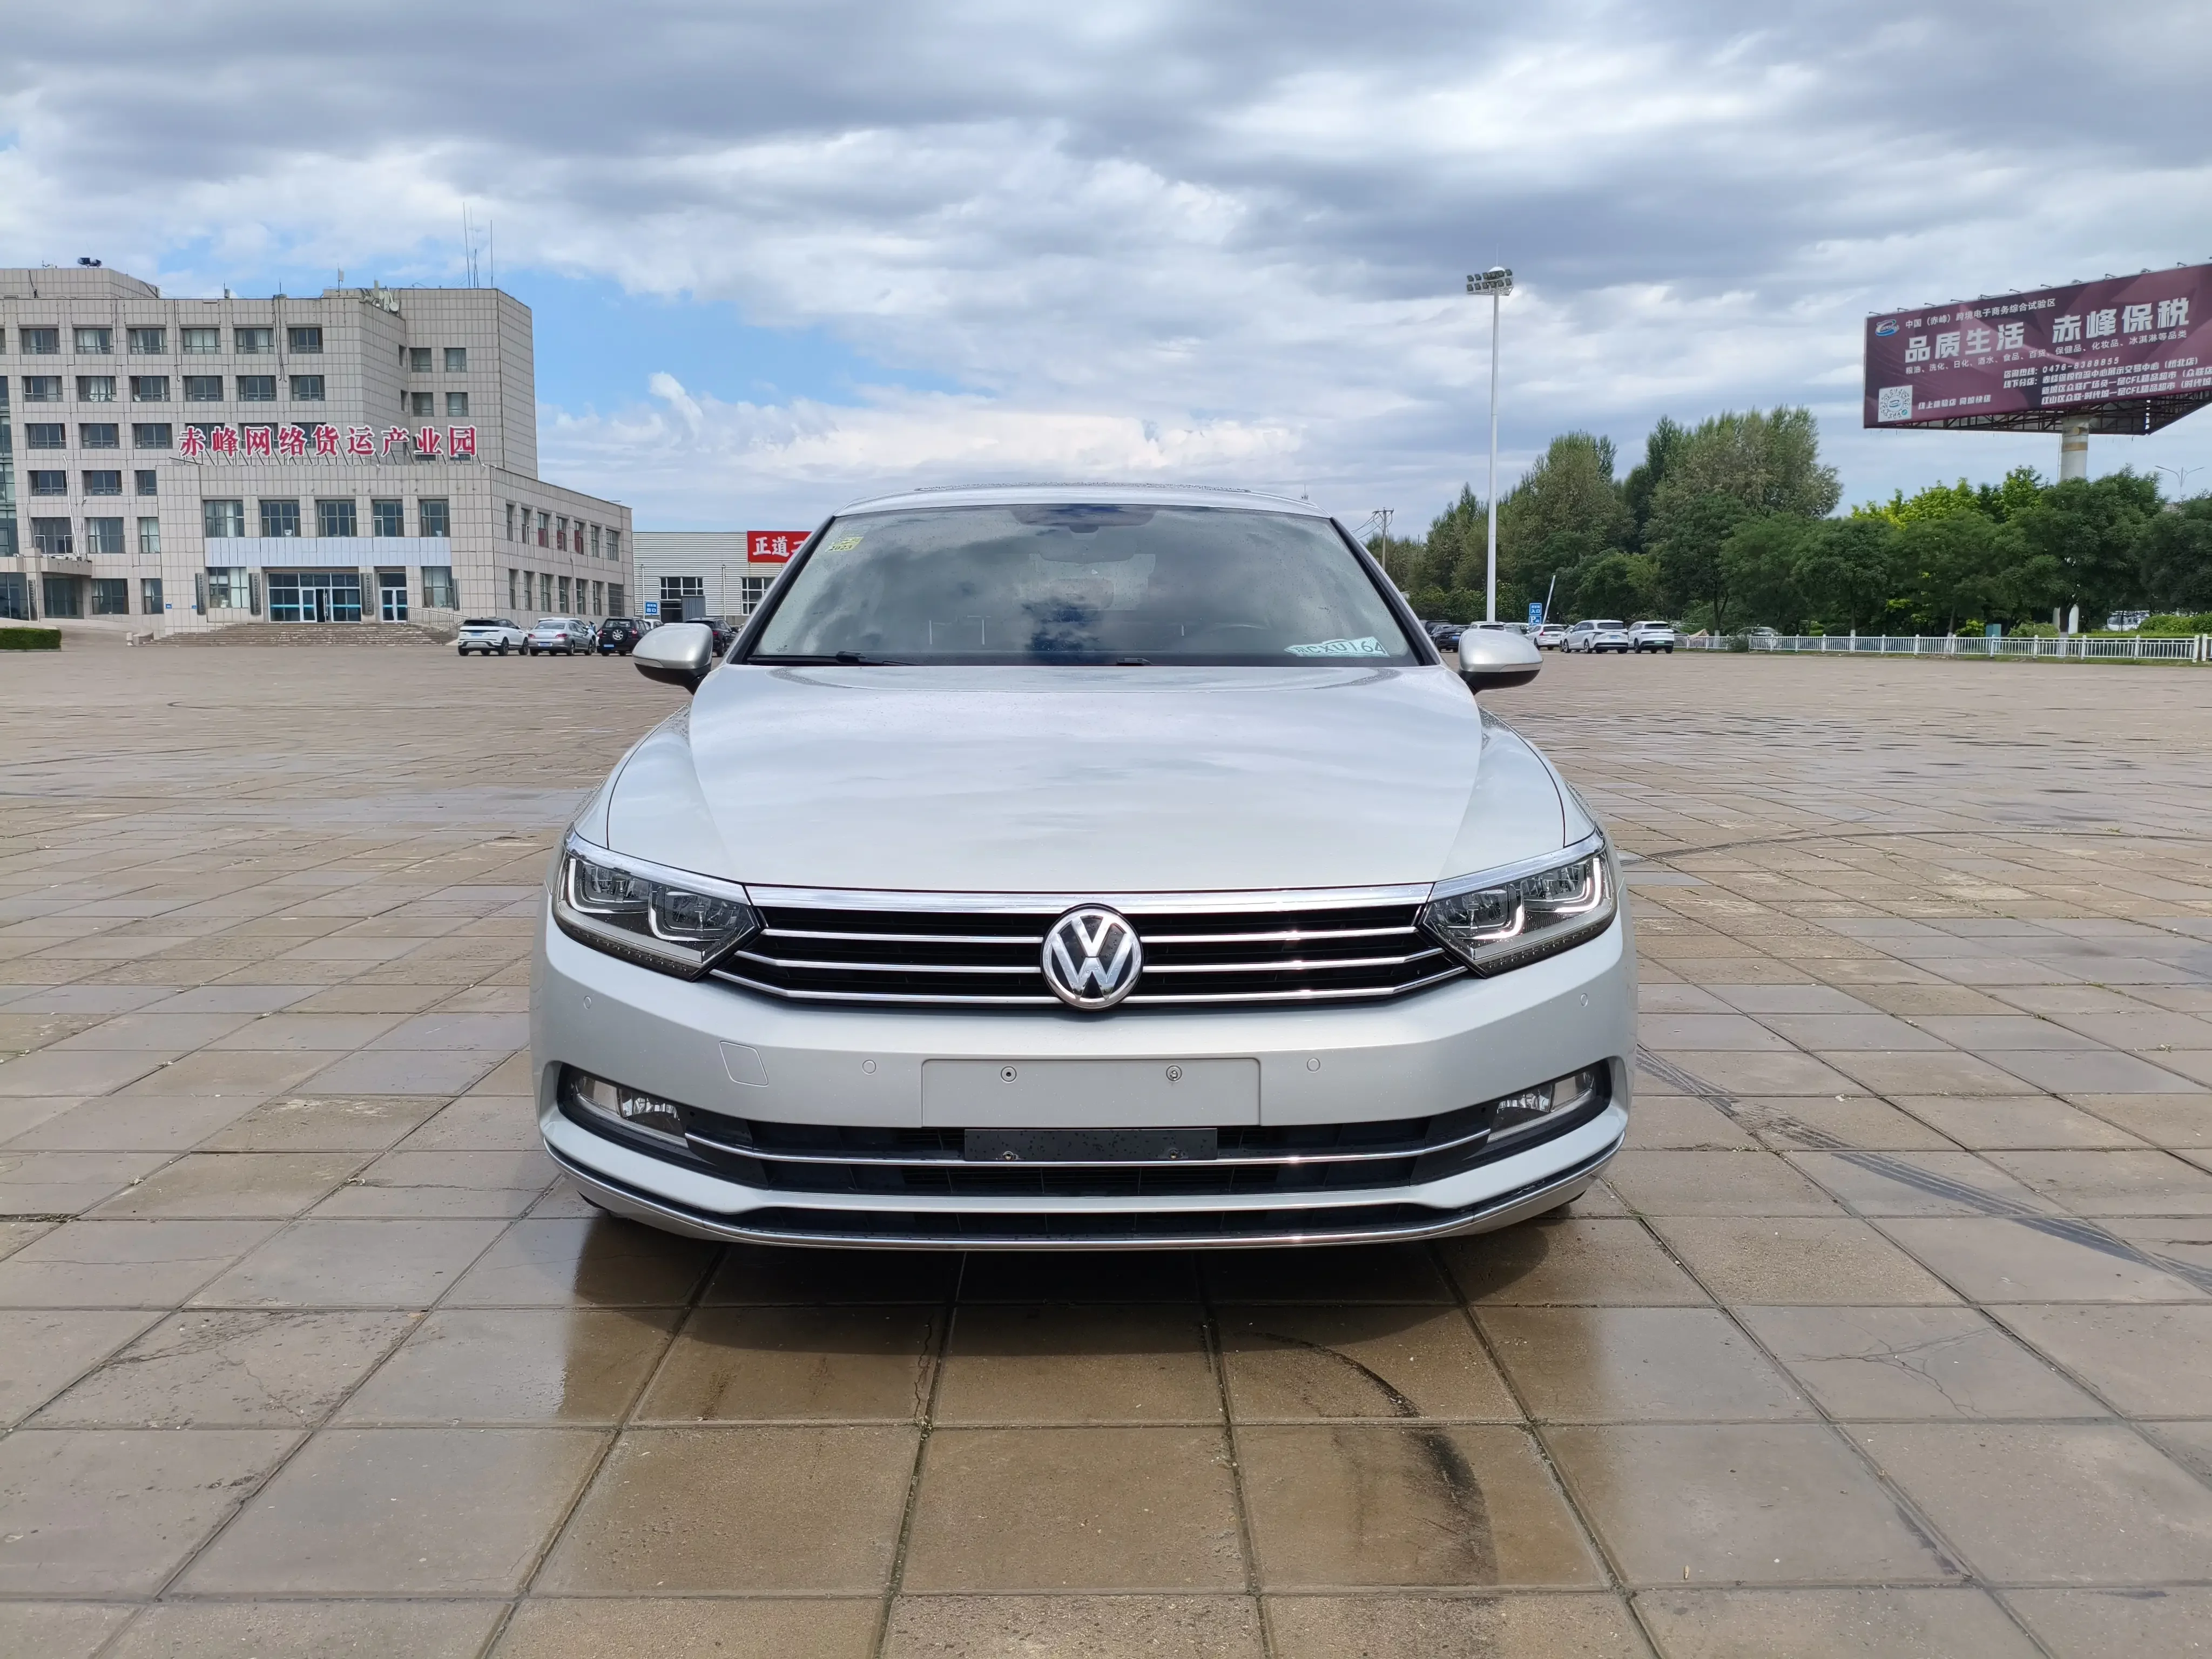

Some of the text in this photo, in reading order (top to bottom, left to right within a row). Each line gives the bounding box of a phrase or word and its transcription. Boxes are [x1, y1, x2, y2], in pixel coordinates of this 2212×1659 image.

[1905, 298, 2189, 363] 品质生活 赤峰保税
[178, 424, 477, 457] 赤峰网络货运产业园
